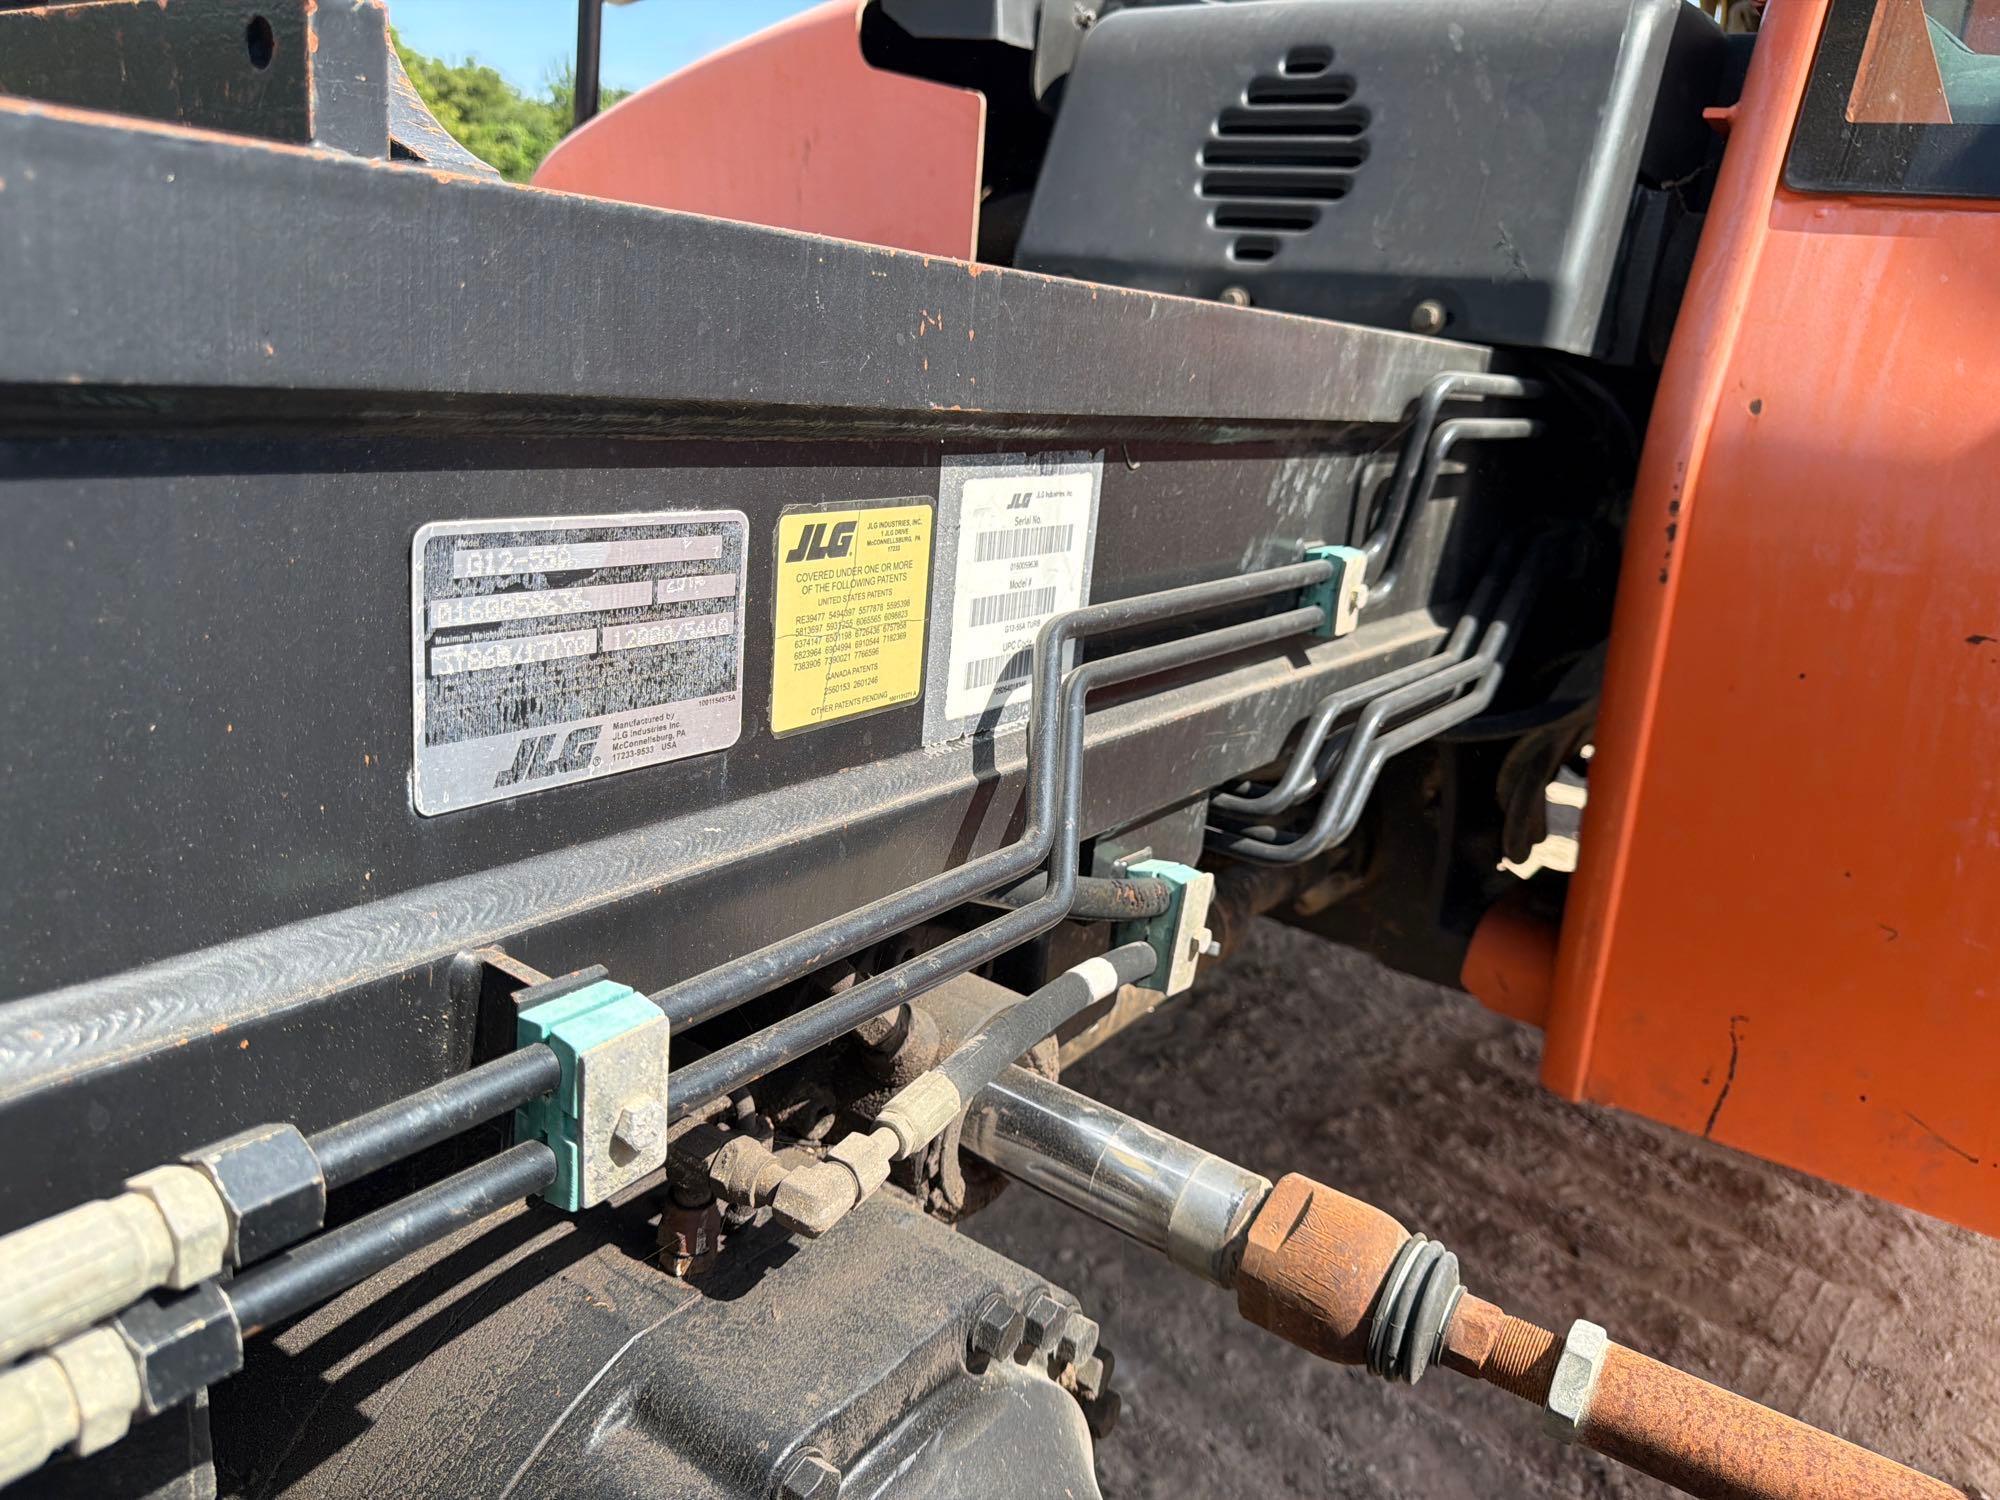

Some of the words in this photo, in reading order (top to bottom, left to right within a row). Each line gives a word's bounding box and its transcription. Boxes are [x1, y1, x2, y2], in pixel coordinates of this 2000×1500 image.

[1006, 492, 1032, 509] JLG
[1014, 516, 1030, 526] Serial
[1032, 514, 1041, 523] No.
[785, 521, 857, 563] JLG
[796, 570, 833, 582] COVERED
[836, 567, 861, 577] UNDER
[863, 564, 879, 573] ONE
[880, 563, 891, 571] OR
[892, 560, 912, 570] MORE
[801, 585, 813, 594] OF
[815, 582, 830, 592] THE
[832, 577, 875, 590] FOLLOWING
[876, 572, 907, 584] PATENTS
[1009, 578, 1027, 589] Model
[818, 595, 840, 605] UNITED
[842, 592, 865, 602] STATES
[866, 588, 892, 598] PATENTS
[435, 632, 469, 644] Maximum
[613, 617, 728, 647] 12000/5440
[1002, 640, 1015, 652] UPC
[825, 668, 852, 680] CANADA
[852, 662, 877, 674] PATENTS
[811, 704, 832, 716] OTHER
[834, 697, 862, 710] PATENTS
[863, 691, 887, 703] PENDING
[612, 714, 663, 729] Manufactured
[665, 712, 674, 721] by
[612, 731, 627, 740] JLG
[630, 723, 666, 737] Industries
[612, 732, 674, 752] McConnellsburg,
[676, 729, 685, 737] PA
[493, 724, 602, 788] JLG
[612, 745, 653, 761] 17233-9533
[661, 741, 676, 750] USA
